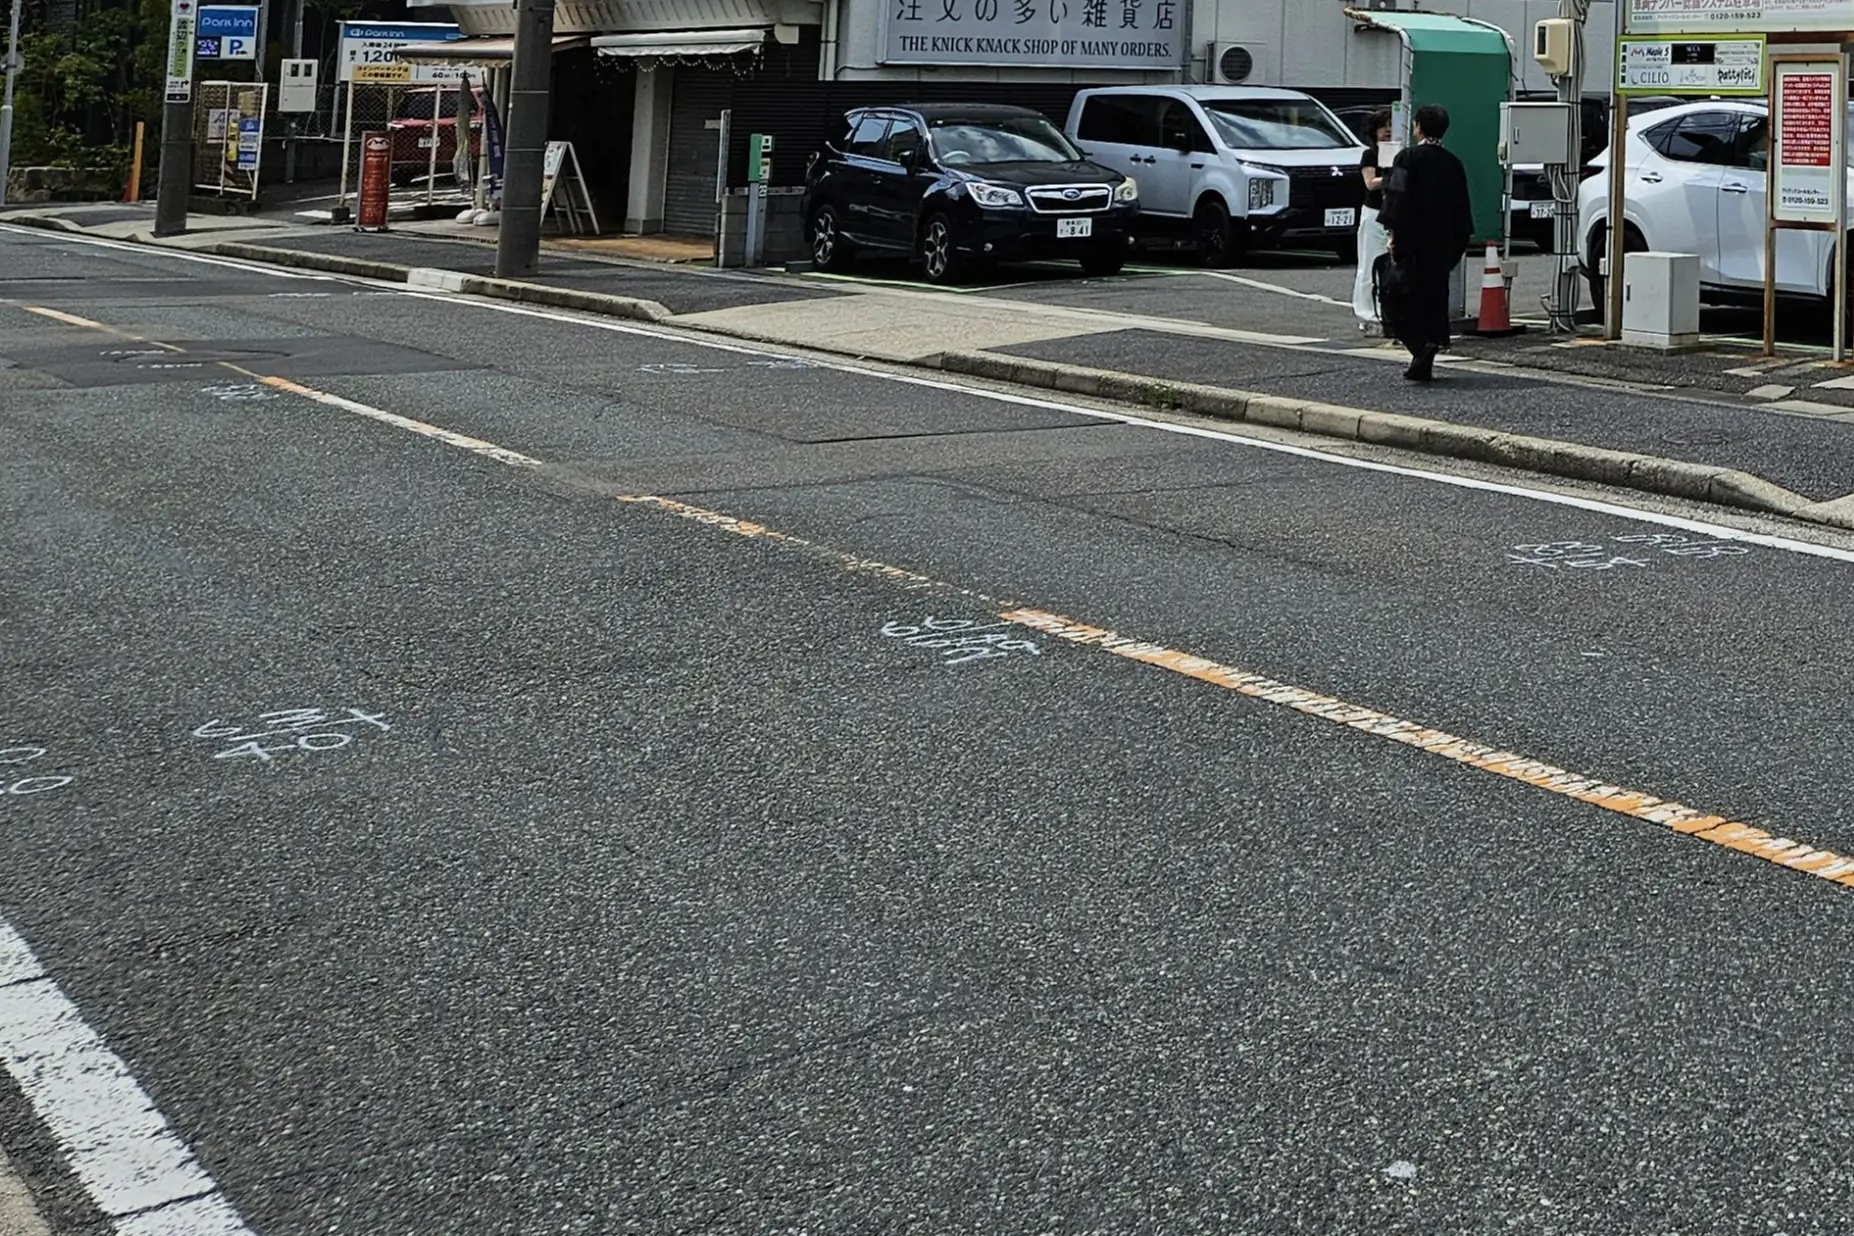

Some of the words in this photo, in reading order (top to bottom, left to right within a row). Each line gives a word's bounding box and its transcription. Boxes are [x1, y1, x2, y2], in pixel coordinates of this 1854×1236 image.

[202, 17, 232, 27] Park
[233, 18, 253, 28] Inn
[229, 39, 243, 55] P
[902, 35, 928, 52] THE
[932, 36, 974, 53] KNICK
[976, 37, 1021, 54] KNACK
[1023, 39, 1058, 55] SHOP
[1061, 40, 1078, 55] OF
[1080, 40, 1119, 57] MANY
[1120, 41, 1173, 58] ORDERS.
[1640, 72, 1669, 84] CILIO
